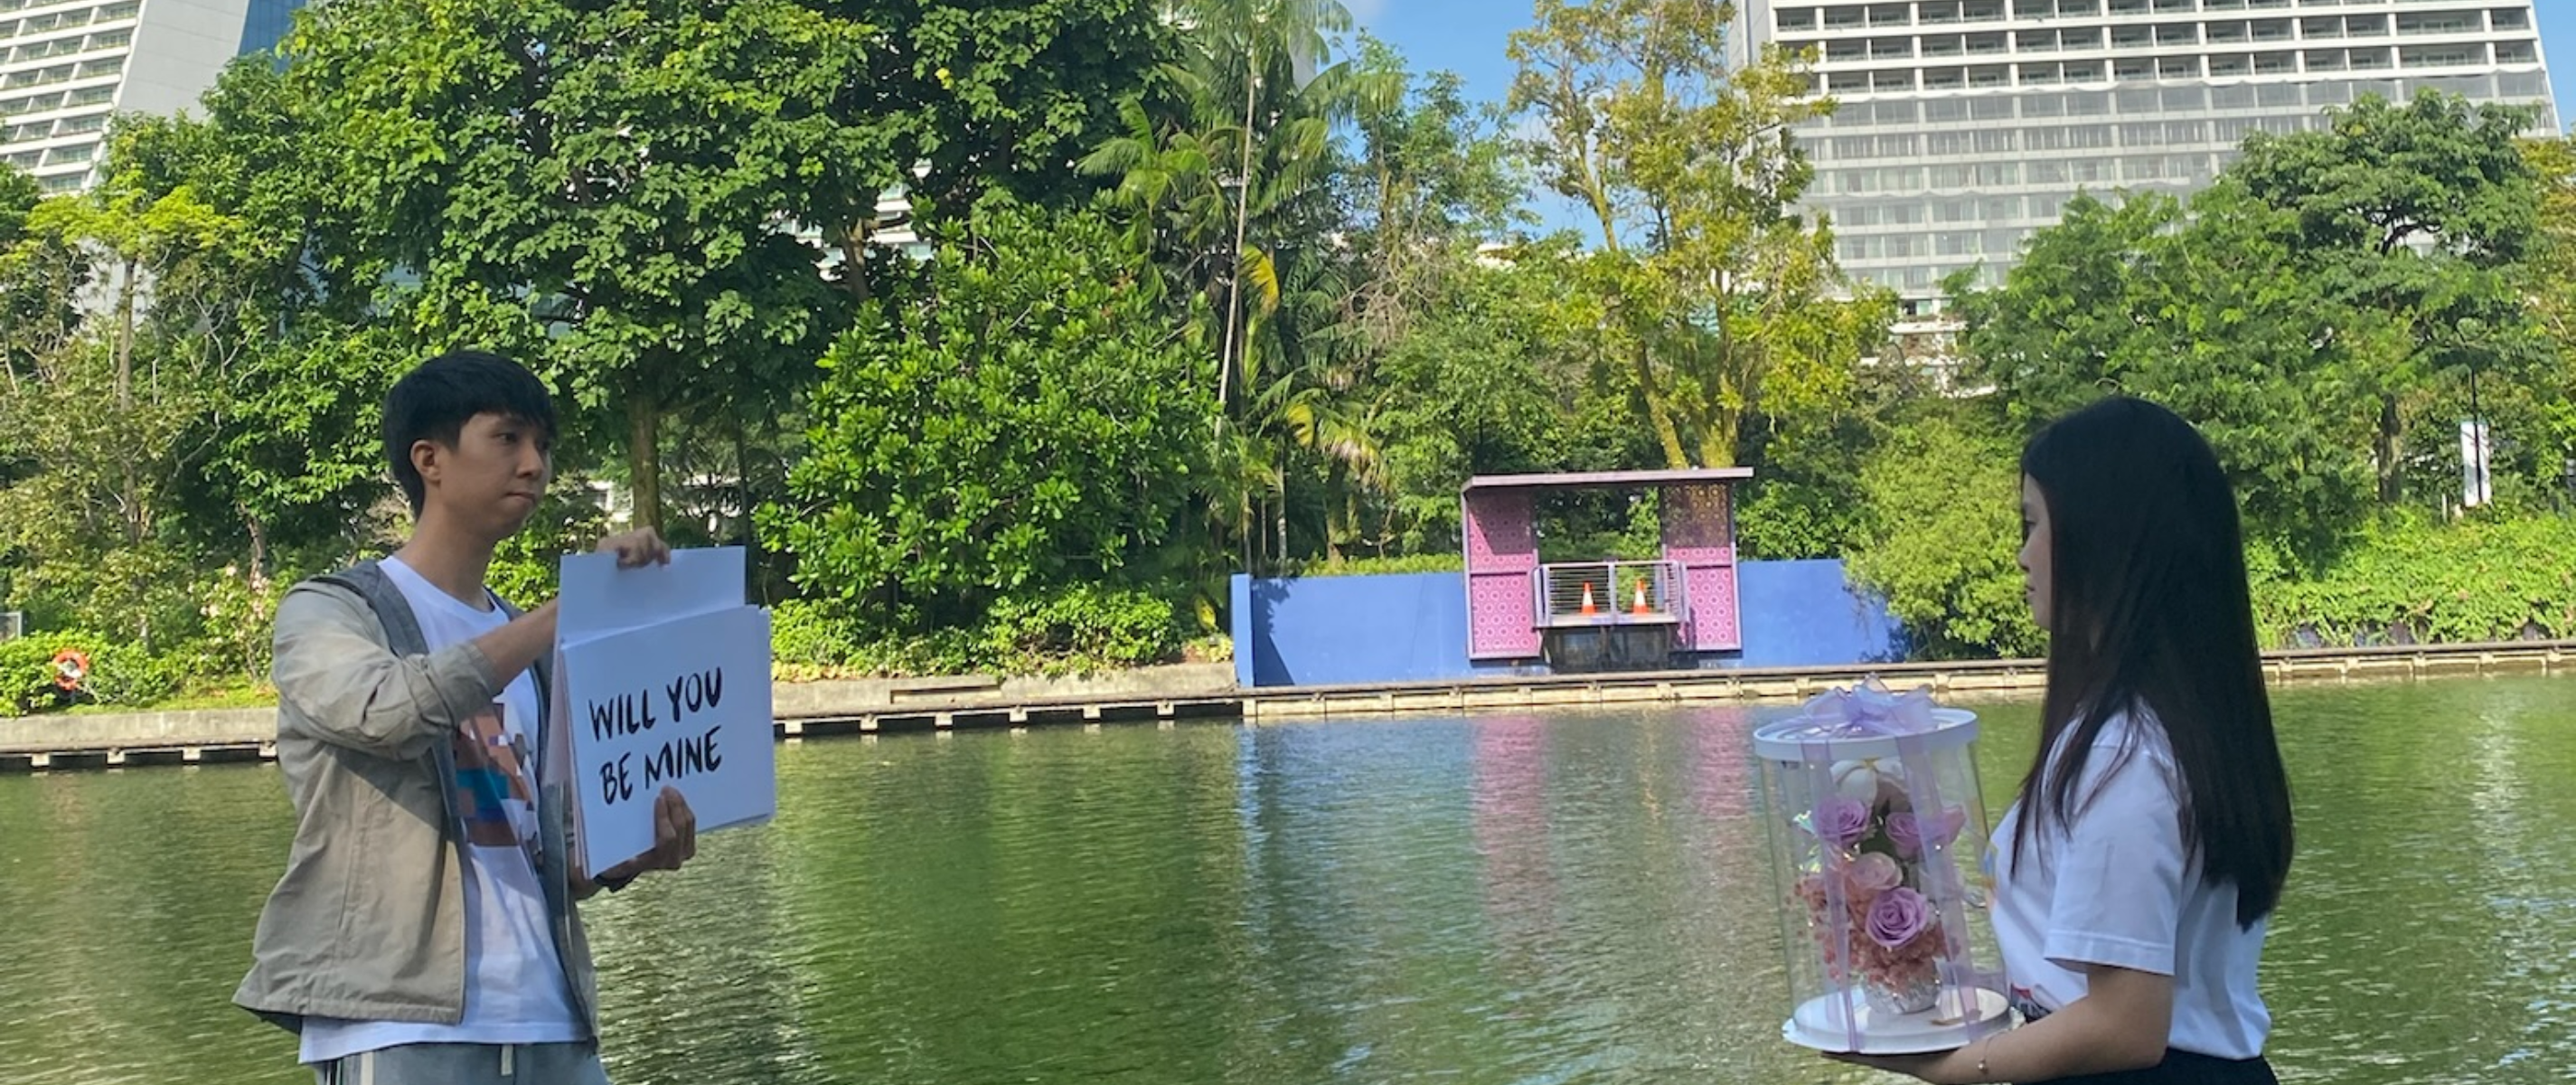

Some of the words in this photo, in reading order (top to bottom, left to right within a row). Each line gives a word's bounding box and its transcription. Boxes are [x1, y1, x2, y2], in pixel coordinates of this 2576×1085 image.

[588, 689, 656, 741] WILL
[666, 666, 722, 722] YOU
[600, 751, 633, 805] BE
[644, 725, 722, 789] MINE
